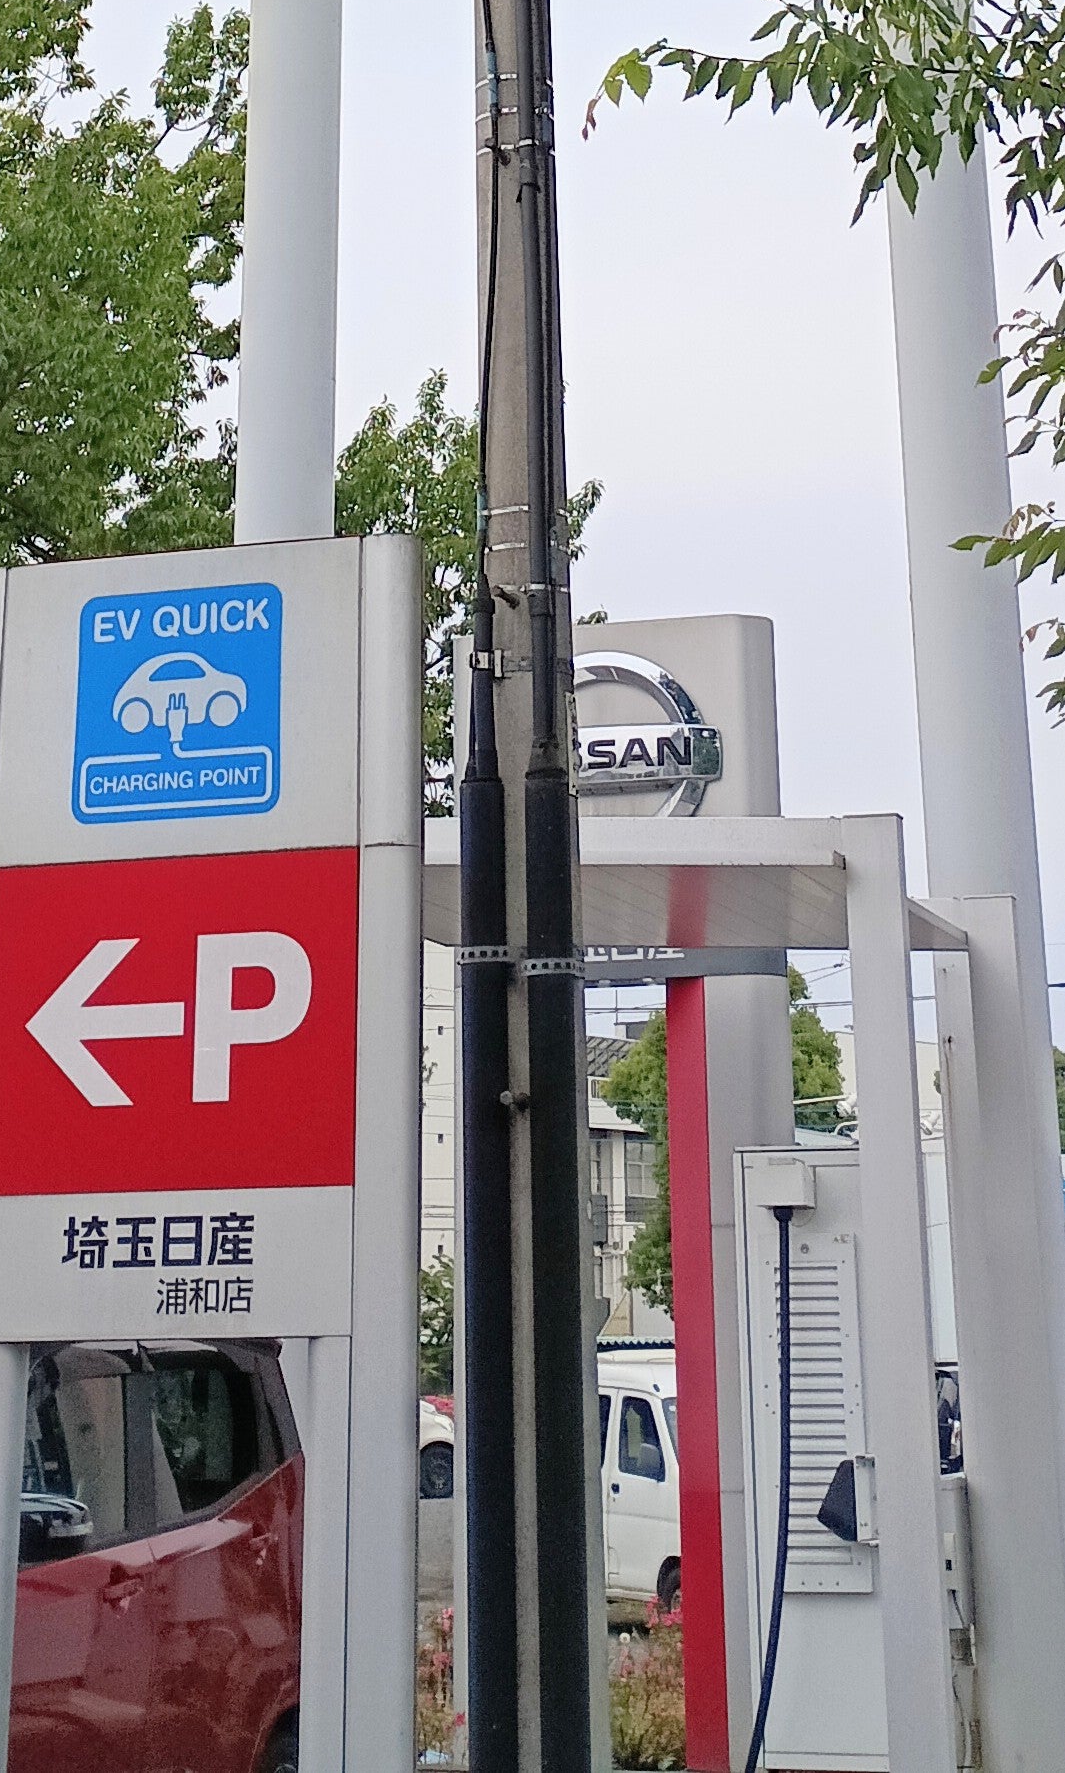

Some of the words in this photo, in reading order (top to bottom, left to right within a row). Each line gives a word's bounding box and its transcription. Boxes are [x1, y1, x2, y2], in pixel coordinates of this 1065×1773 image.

[93, 608, 140, 643] EV
[152, 598, 270, 638] QUICK
[89, 770, 194, 796] CHARGING
[199, 766, 262, 788] POINT
[192, 931, 312, 1103] P
[61, 1211, 255, 1269] 埼玉日産
[155, 1277, 254, 1315] 浦和店
